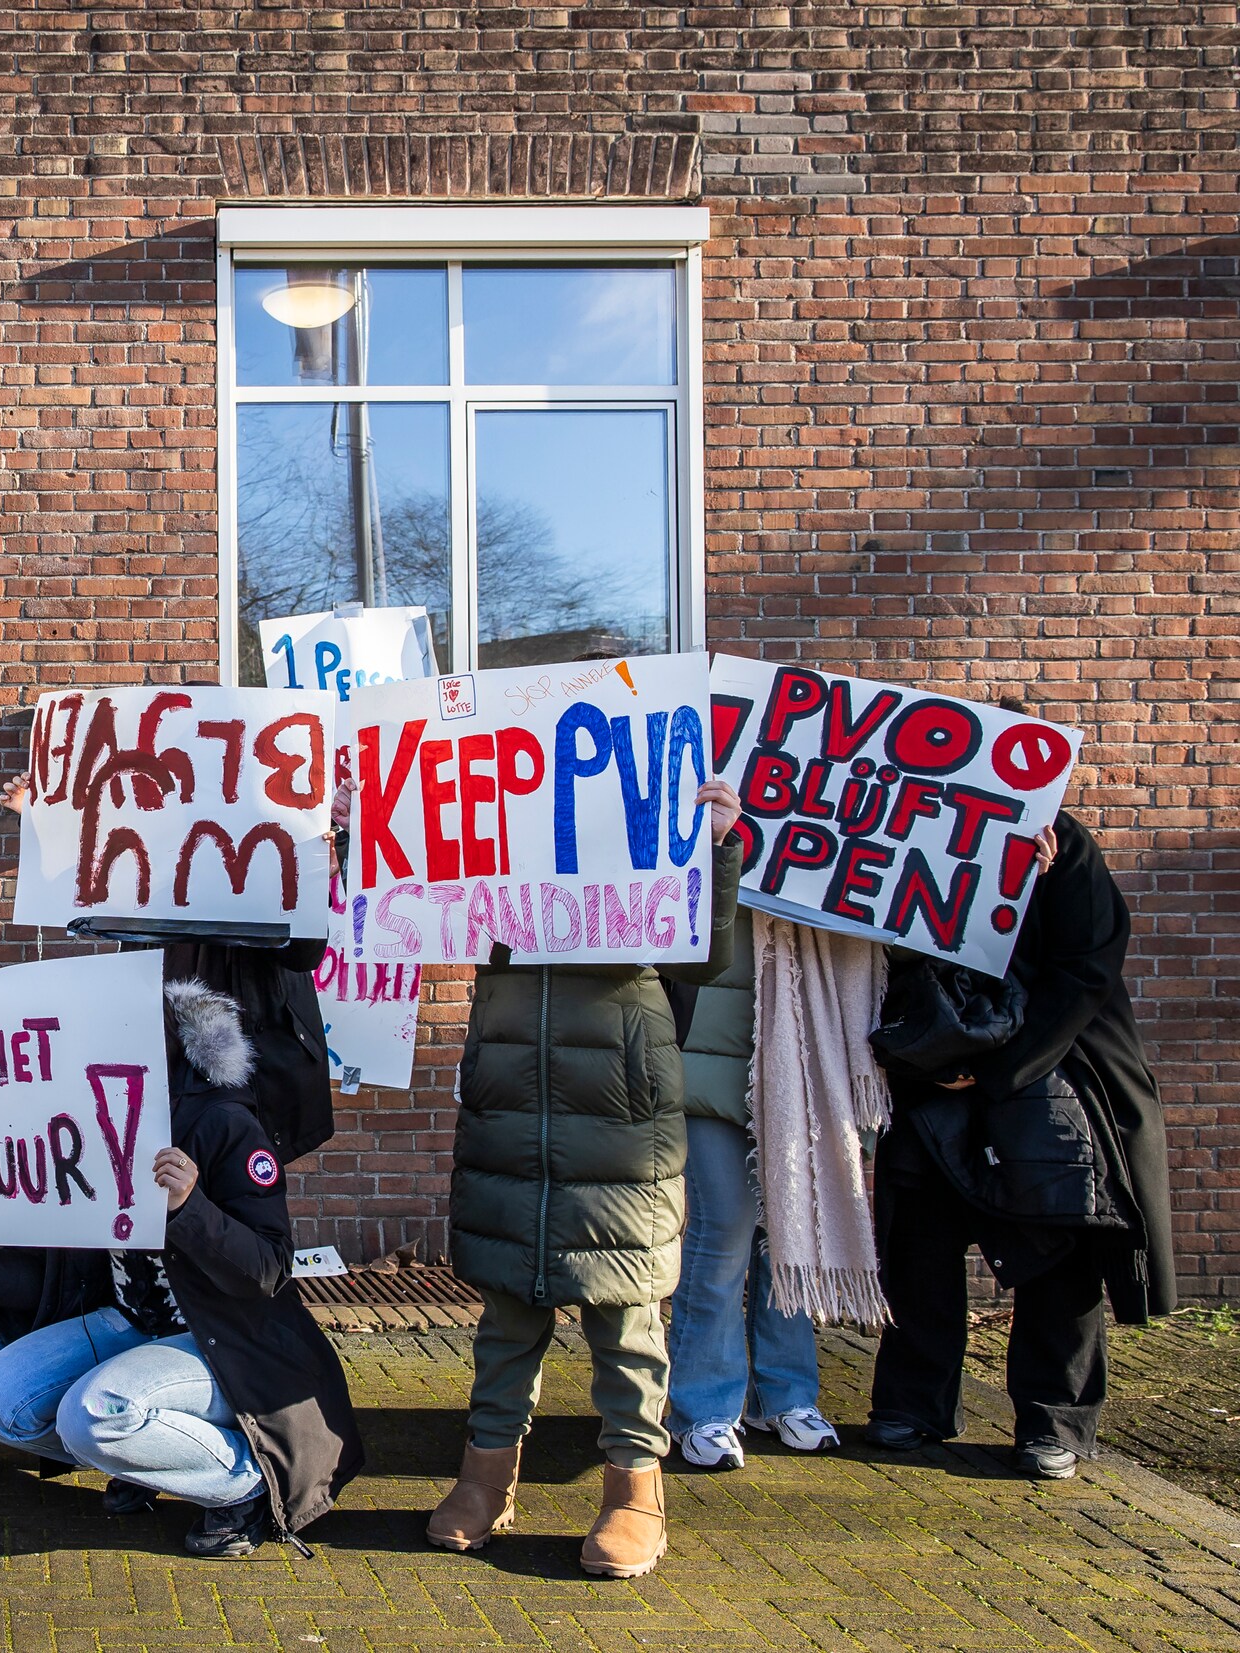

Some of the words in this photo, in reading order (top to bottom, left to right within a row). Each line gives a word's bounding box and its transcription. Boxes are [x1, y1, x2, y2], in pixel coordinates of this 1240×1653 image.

[271, 633, 305, 689] 1
[760, 666, 984, 776] PVO
[358, 719, 546, 889] KEEP
[554, 702, 706, 876] PVO
